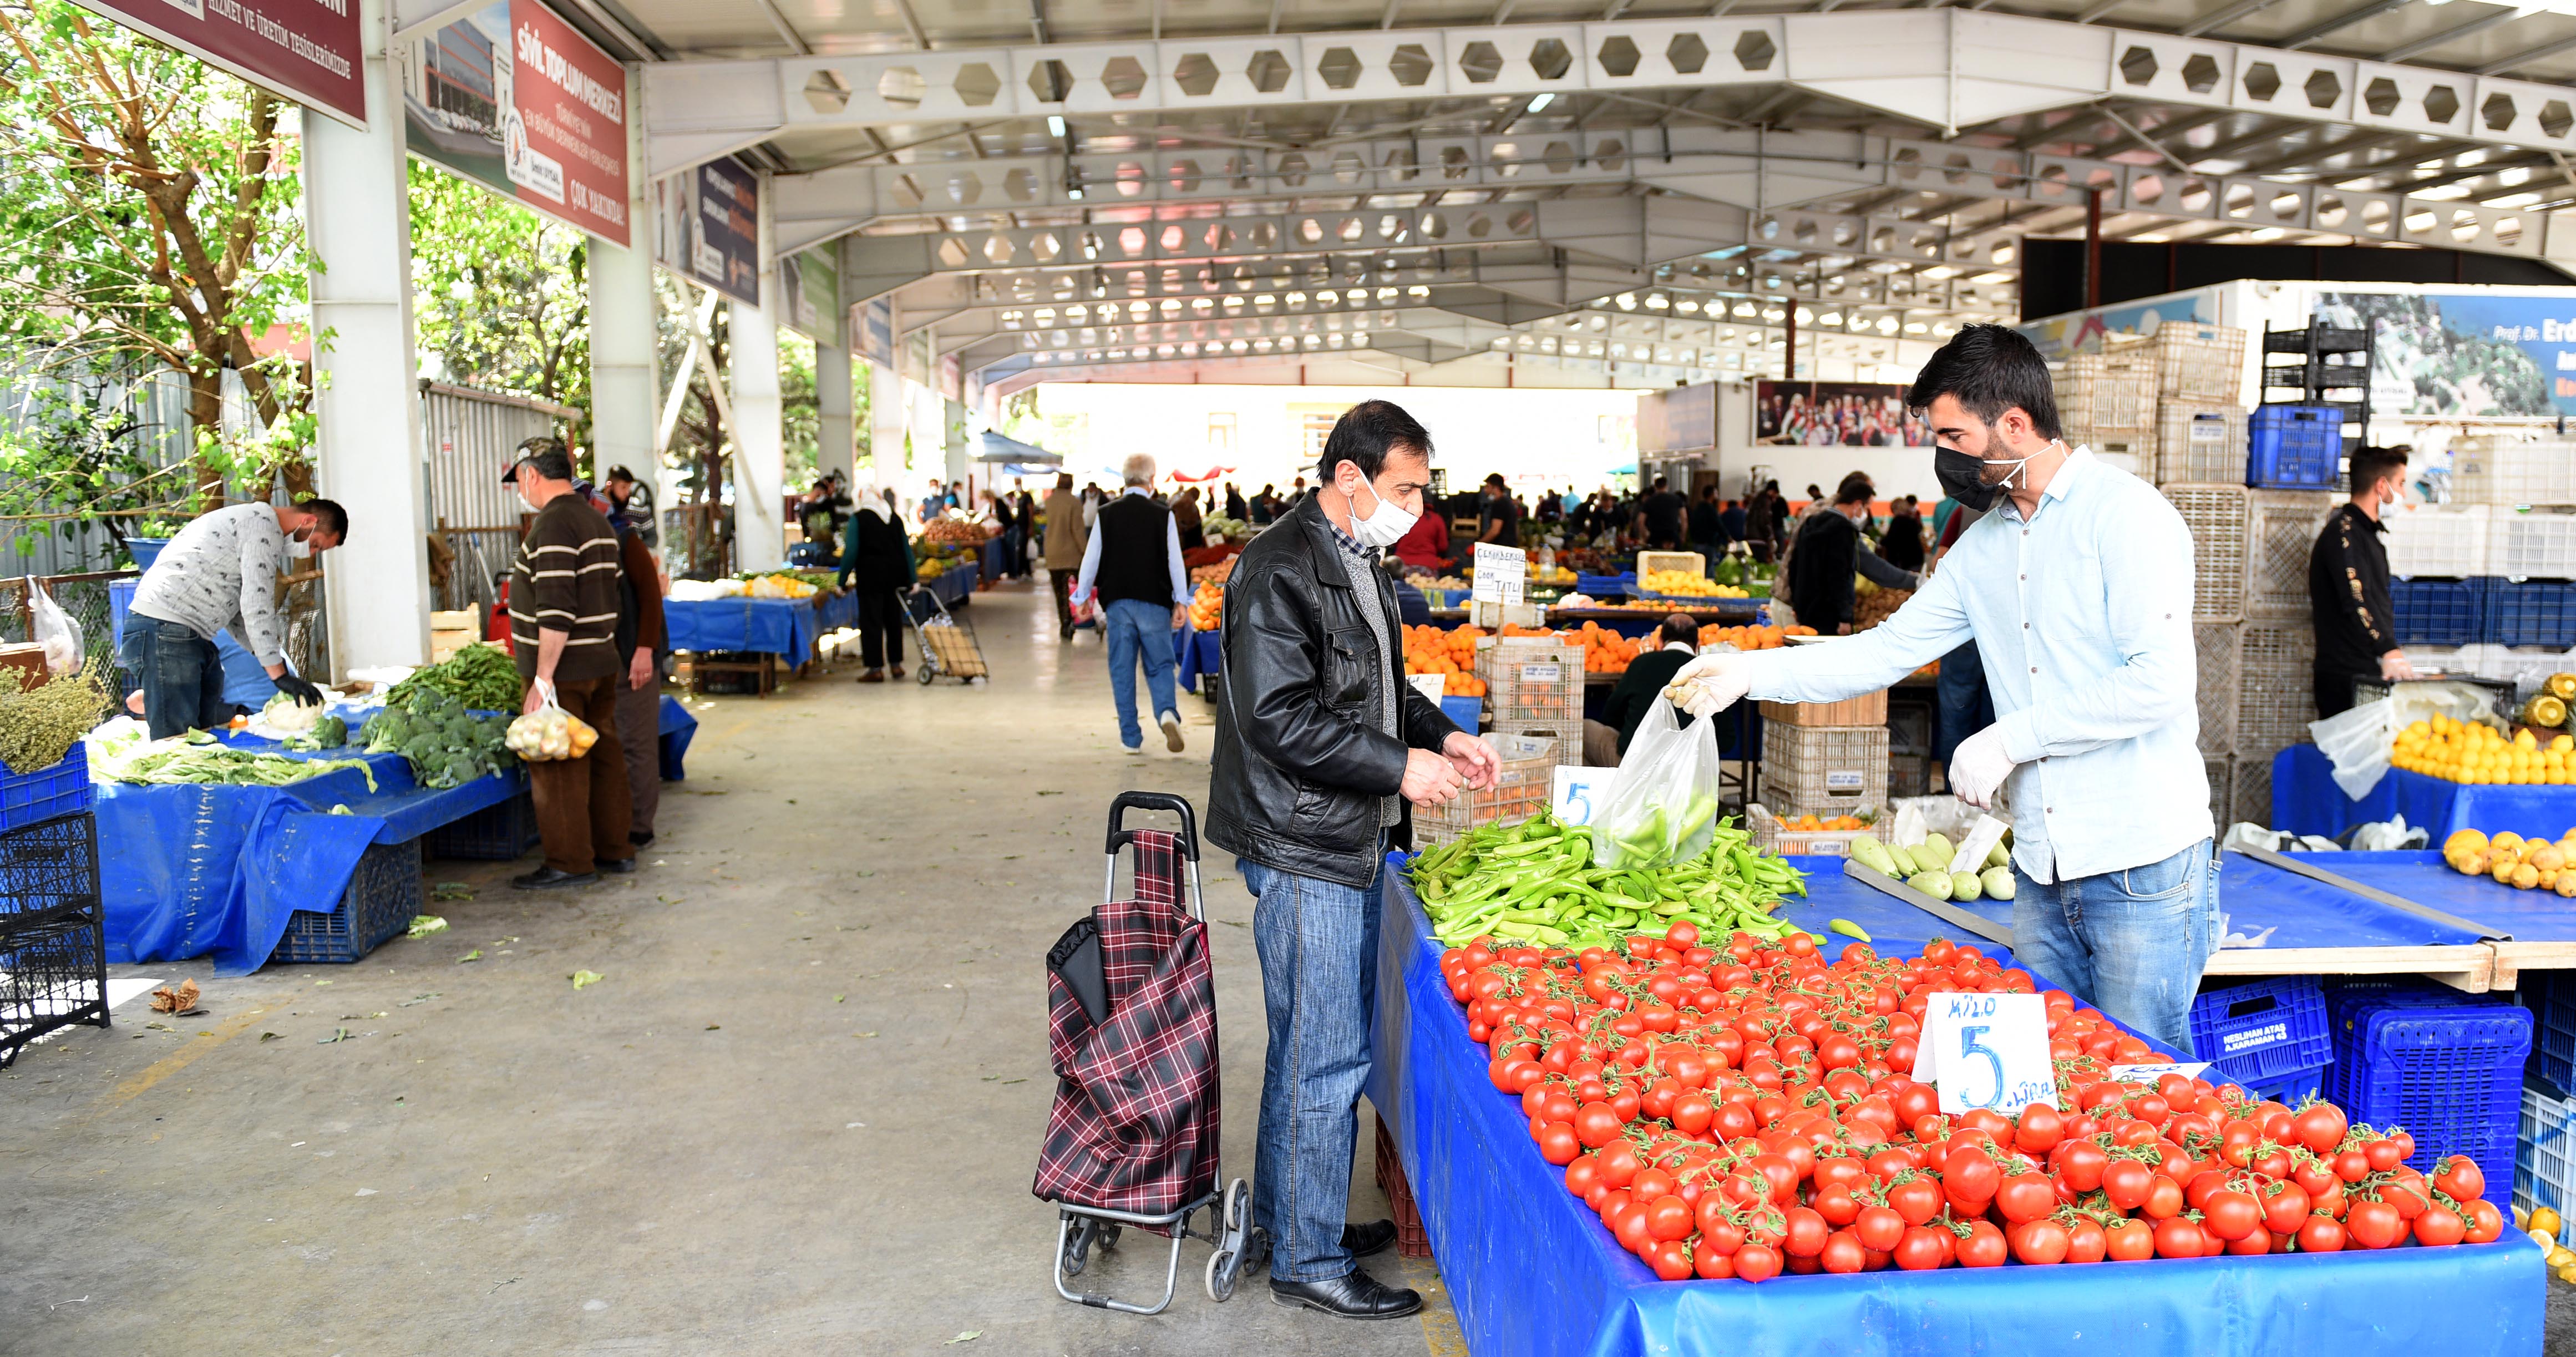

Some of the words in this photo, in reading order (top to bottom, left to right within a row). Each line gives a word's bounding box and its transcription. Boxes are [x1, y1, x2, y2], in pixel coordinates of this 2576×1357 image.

[242, 6, 255, 32] VE
[256, 9, 290, 49] ÜRETİM
[290, 33, 352, 80] TESİSLERİMİZDE
[518, 21, 546, 75] SİVİL
[544, 45, 582, 102] TOPLUM
[570, 178, 588, 211] ÇOK
[2493, 325, 2521, 343] Prof.
[2523, 326, 2539, 342] Dr.
[1562, 783, 1591, 827] 5
[1960, 1026, 2004, 1108] 5
